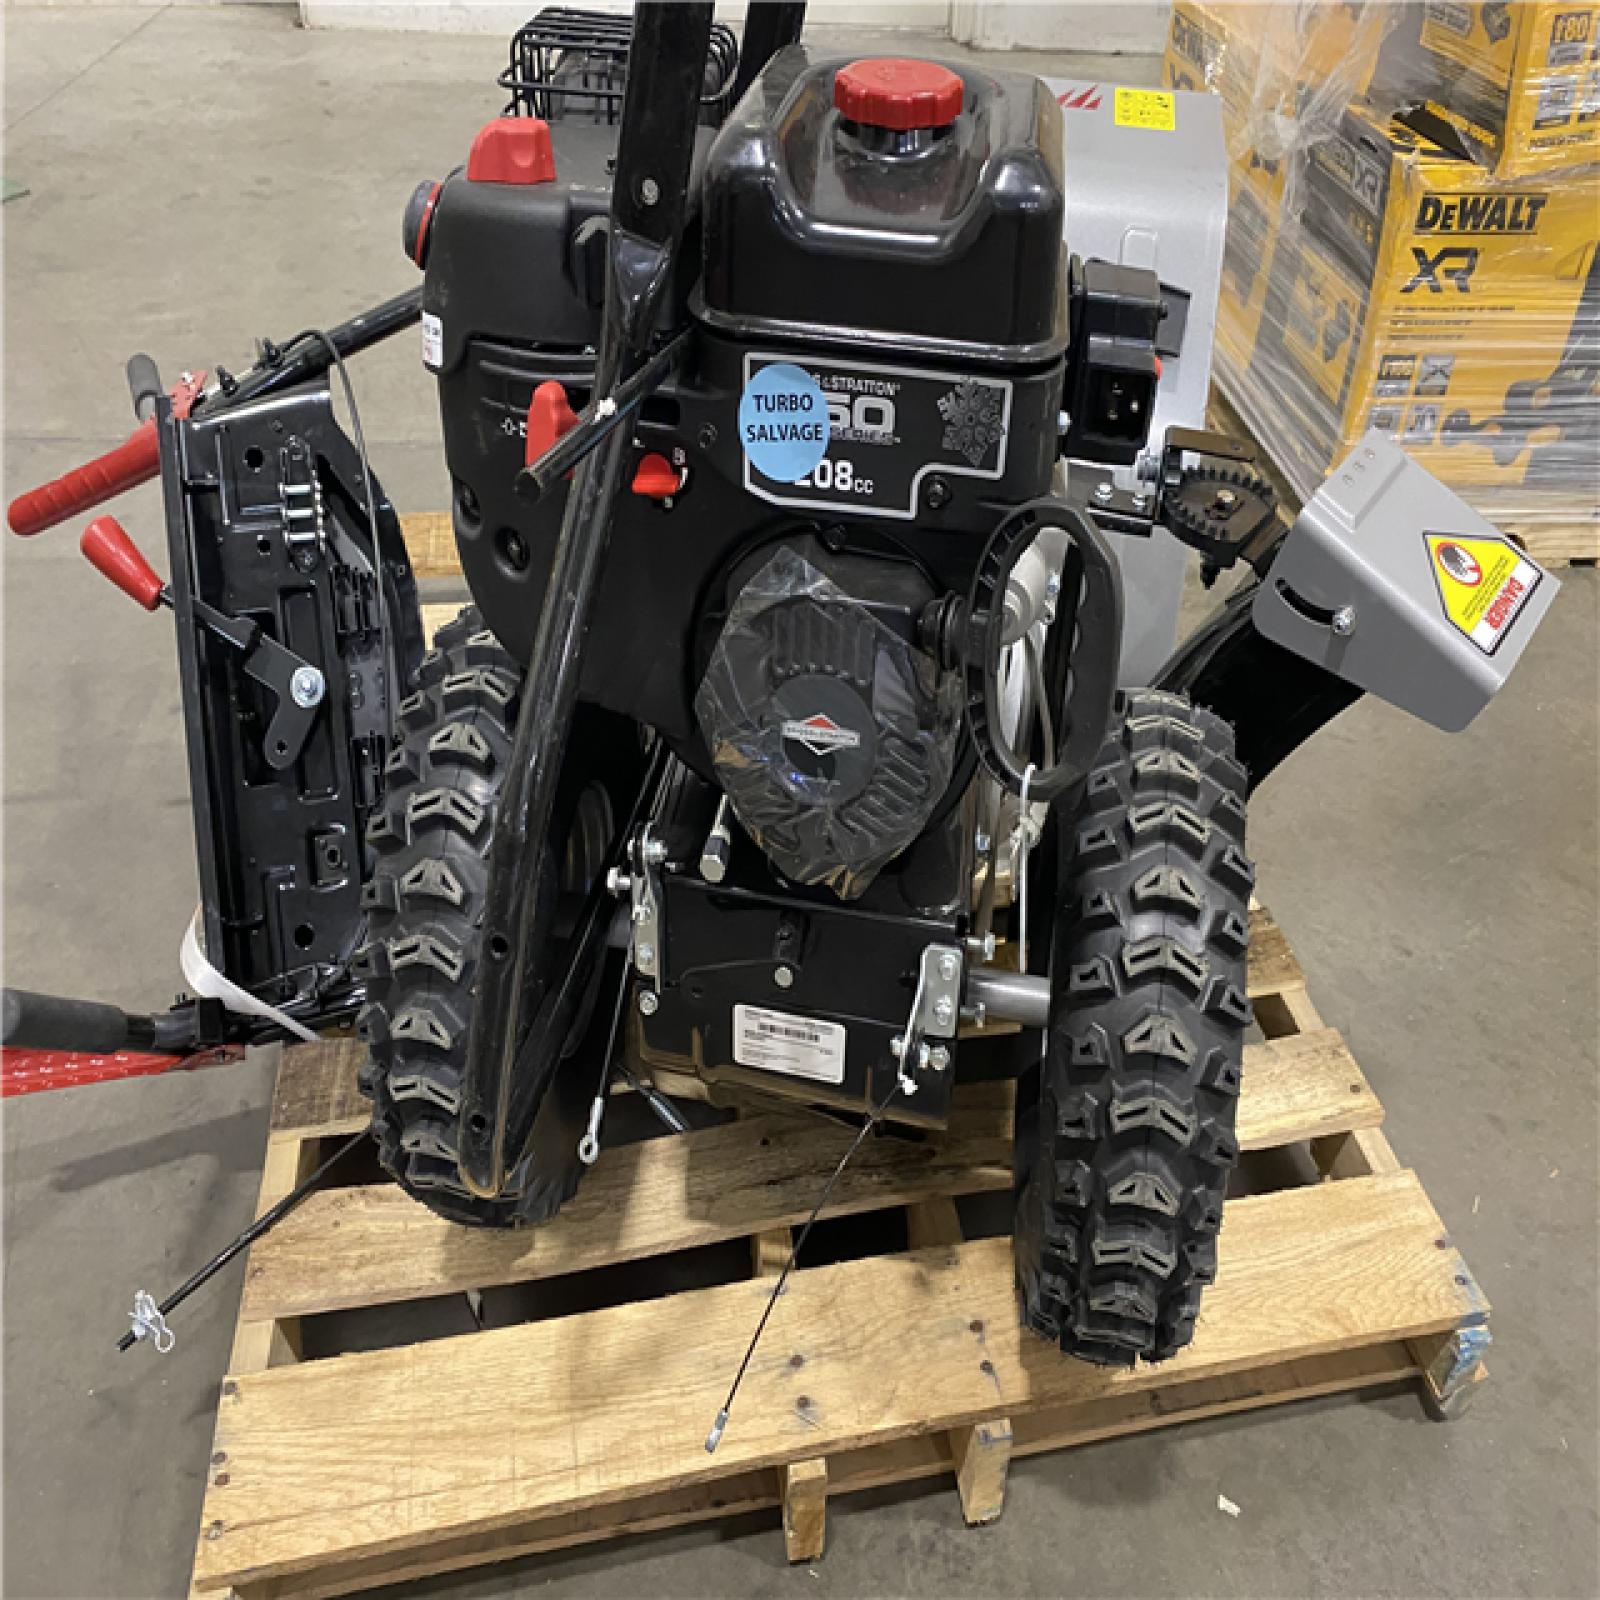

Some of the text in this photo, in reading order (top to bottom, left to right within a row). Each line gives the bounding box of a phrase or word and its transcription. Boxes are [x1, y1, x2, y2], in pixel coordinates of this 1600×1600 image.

[1415, 196, 1545, 230] DeWALT
[1400, 247, 1478, 292] XR
[752, 394, 814, 412] TURBO
[746, 424, 823, 443] SALVAGE
